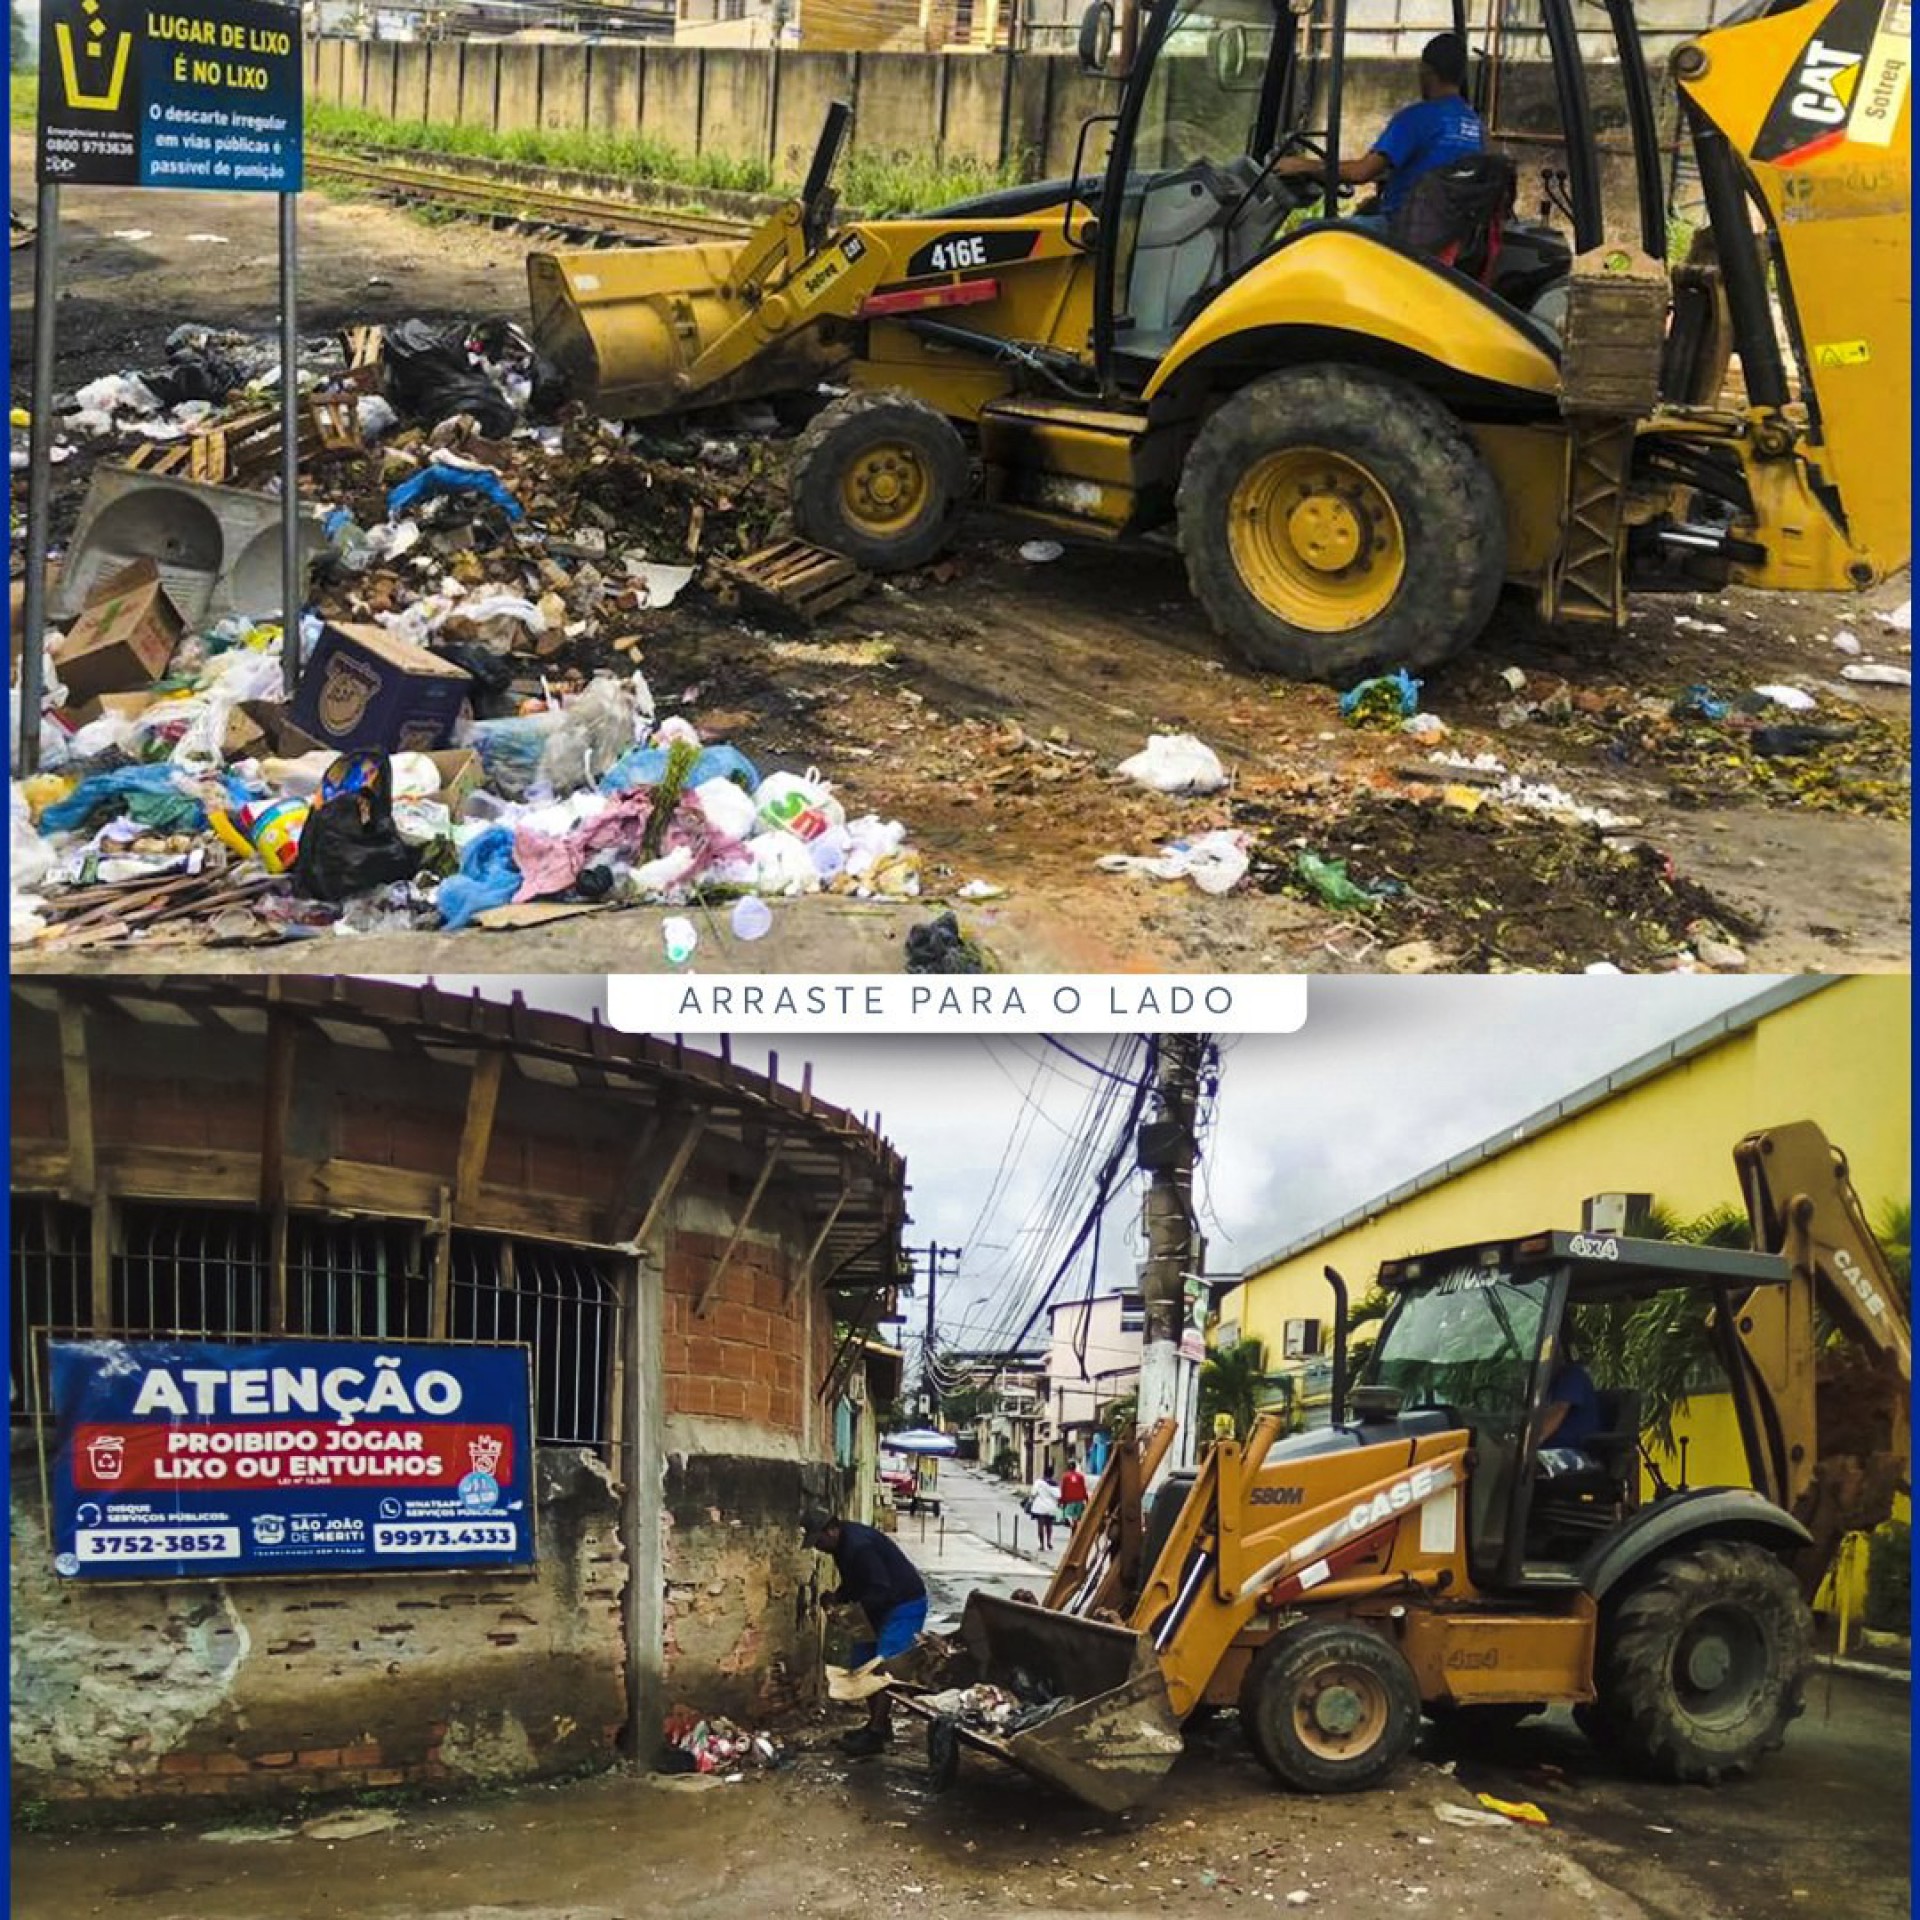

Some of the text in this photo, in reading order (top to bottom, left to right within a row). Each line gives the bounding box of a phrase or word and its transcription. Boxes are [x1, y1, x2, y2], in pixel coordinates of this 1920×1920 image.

[148, 13, 290, 55] LUGAR DE LIXO
[174, 51, 268, 90] É NO LIXO
[1791, 39, 1863, 124] CAT
[149, 103, 287, 132] O descarte irregular
[46, 138, 79, 152] 0800
[155, 134, 178, 147] em
[182, 134, 212, 150] vias
[214, 135, 270, 154] públicas
[213, 160, 230, 176] de
[234, 162, 285, 180] punição
[931, 236, 986, 270] 416E
[1833, 1249, 1885, 1316] CASE
[132, 1355, 463, 1427] ATENÇÃO
[168, 1430, 423, 1453] PROIBIDO JOGAR
[154, 1455, 443, 1480] LIXO OU ENTULHOS
[1250, 1487, 1304, 1505] 580M
[1348, 1465, 1434, 1530] CASE
[106, 1504, 151, 1513] DISQUE
[106, 1513, 166, 1523] SERVIÇOS
[405, 1509, 456, 1518] SERVIÇOS
[290, 1516, 363, 1531] SÃO JOÃO
[91, 1534, 227, 1554] 3752-3852
[291, 1530, 365, 1543] DE MERITI
[379, 1529, 511, 1546] 99973.4333
